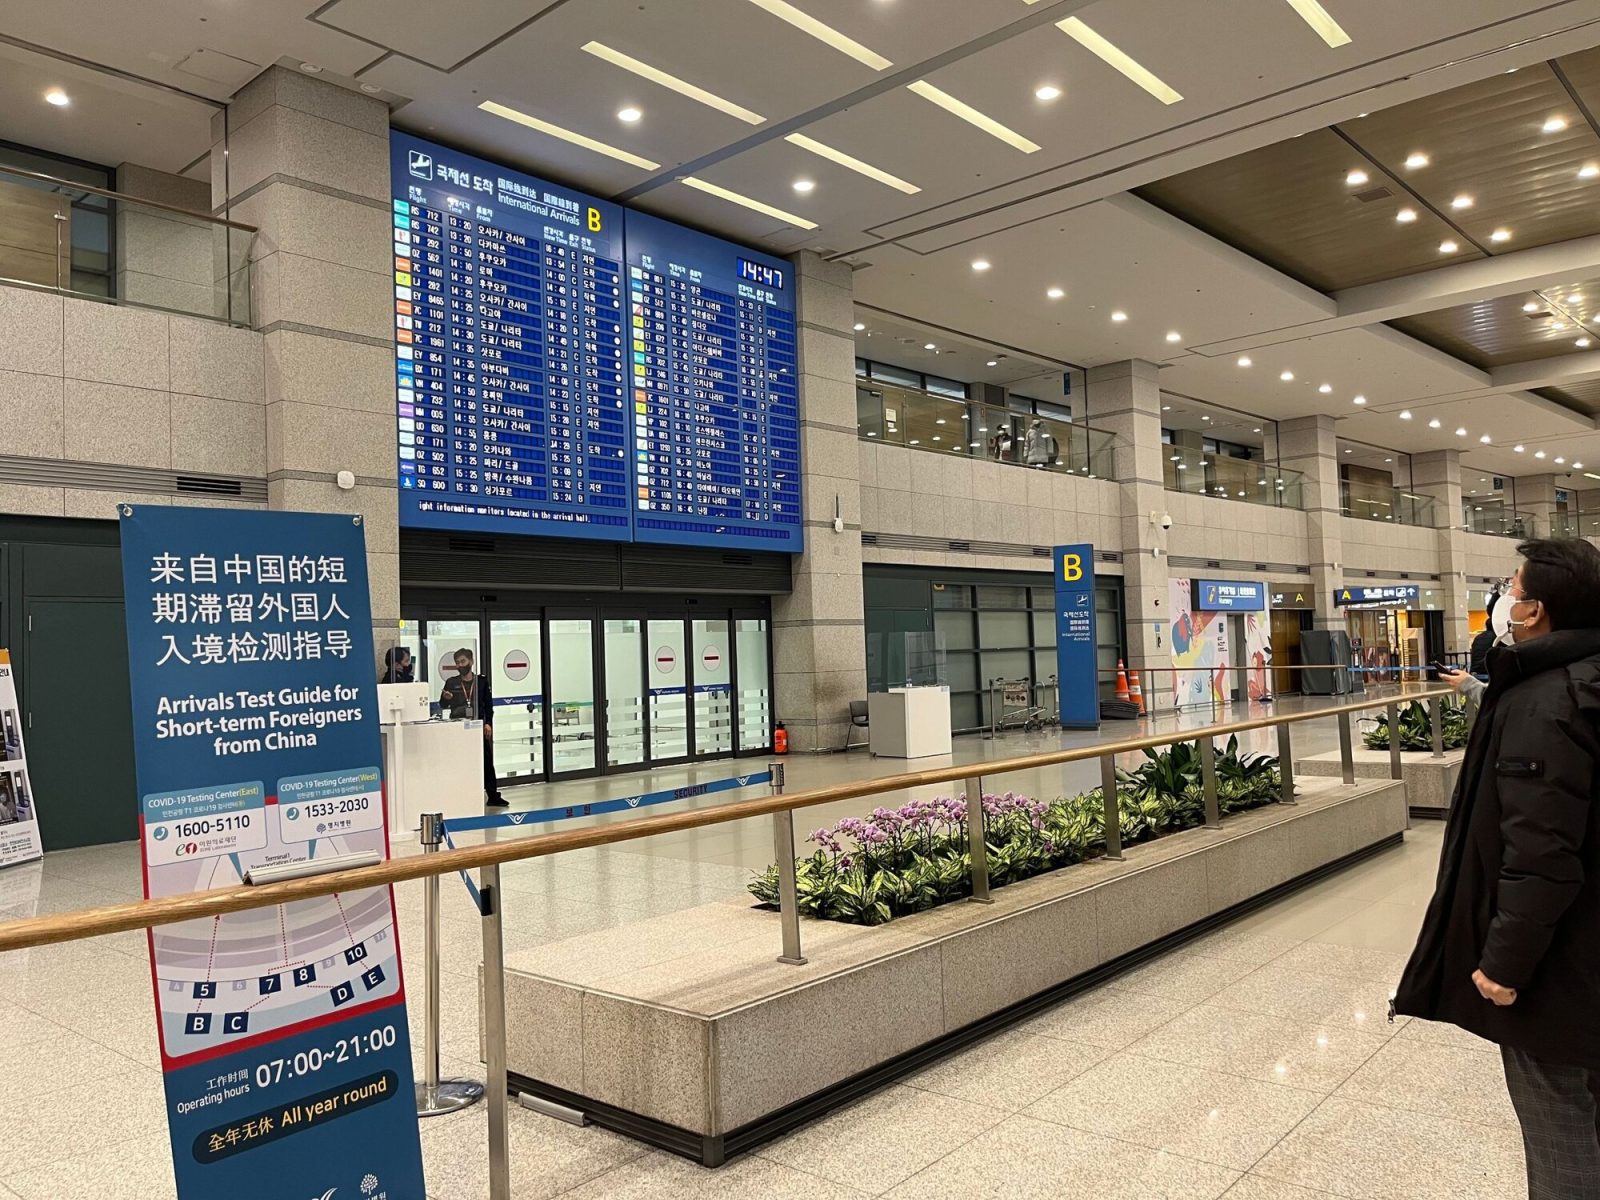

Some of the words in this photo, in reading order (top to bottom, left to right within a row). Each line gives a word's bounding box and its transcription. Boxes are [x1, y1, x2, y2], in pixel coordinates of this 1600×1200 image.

[437, 164, 470, 188] 국제선
[473, 177, 493, 195] 도착
[409, 193, 427, 205] Flight
[498, 192, 549, 217] International
[550, 209, 580, 226] Arrivals
[476, 213, 491, 222] From
[588, 207, 601, 232] B
[427, 210, 438, 221] 712
[478, 225, 502, 239] 오사카/
[505, 232, 525, 245] 간사이
[582, 254, 594, 265] 지연
[411, 248, 420, 258] OZ
[479, 265, 492, 276] 로마
[427, 224, 438, 234] 742
[478, 238, 505, 253] 다카마쓰
[583, 267, 594, 277] 도착
[478, 251, 506, 267] 후쿠오카
[583, 280, 595, 289] 도착
[743, 261, 782, 289] 14:47
[428, 266, 442, 277] 1401
[479, 279, 507, 293] 후쿠오카
[583, 305, 595, 315] 지연
[412, 291, 421, 300] EY
[584, 330, 596, 340] 도착
[429, 308, 443, 319] 1101
[480, 320, 498, 331] 도쿄/
[500, 324, 521, 336] 나리타
[479, 293, 504, 305] 오사카/
[507, 298, 527, 311] 간사이
[584, 317, 596, 327] 도착
[428, 322, 441, 333] 212
[480, 333, 498, 344] 도쿄/
[501, 338, 521, 349] 나리타
[585, 355, 597, 365] 도착
[414, 349, 422, 359] EY
[480, 362, 508, 375] 아부다비
[586, 382, 598, 391] 도착
[480, 347, 501, 359] 삿포로
[585, 368, 597, 377] 도착
[430, 367, 441, 376] 171
[481, 376, 506, 388] 오사카/
[509, 380, 529, 392] 간사이
[586, 395, 598, 404] 도착
[430, 381, 442, 390] 404
[586, 407, 598, 417] 지연
[430, 395, 443, 405] 732
[482, 403, 500, 413] 도쿄/
[503, 406, 523, 417] 나리타
[587, 420, 599, 430] 지연
[483, 417, 507, 428] 오사카/
[510, 420, 530, 432] 간사이
[415, 435, 424, 444] OZ
[432, 437, 443, 446] 171
[483, 444, 511, 456] 오키나와
[483, 430, 497, 441] 홍콩
[588, 445, 600, 454] 도착
[770, 449, 779, 457] 지연
[416, 450, 424, 459] OZ
[431, 451, 444, 461] 502
[484, 485, 512, 496] 싱가포르
[589, 483, 601, 492] 지연
[771, 481, 780, 490] 지연
[419, 501, 433, 511] ight
[436, 502, 475, 514] information
[507, 508, 530, 518] located
[532, 510, 539, 519] in
[541, 511, 551, 520] the
[553, 512, 573, 521] arrival
[697, 495, 710, 503] 도쿄/
[150, 552, 347, 585] 来自中国的短
[1063, 553, 1083, 581] B
[1296, 593, 1304, 602] A
[1341, 590, 1351, 600] A
[152, 592, 350, 624] 期滞留外国人
[156, 630, 353, 666] 入境检测指导
[157, 692, 234, 716] Arrivals
[236, 689, 276, 708] Test
[279, 686, 331, 706] Guide
[333, 684, 359, 702] for
[156, 713, 266, 739] Short-term
[269, 707, 362, 731] Foreigners
[213, 736, 261, 756] from
[264, 731, 317, 751] China
[280, 780, 313, 792] COVID-19
[314, 779, 337, 788] Testing
[674, 784, 708, 800] SECURITY
[148, 796, 186, 809] COVID-19
[187, 793, 214, 803] Testing
[305, 797, 369, 819] 1533-2030
[175, 815, 250, 838] 1600-5110
[348, 947, 363, 960] 10
[266, 979, 274, 990] 7
[299, 968, 309, 981] 8
[368, 972, 379, 985] E
[200, 984, 209, 996] 5
[337, 987, 348, 1001] D
[193, 1017, 205, 1031] B
[231, 1017, 242, 1030] C
[256, 1024, 396, 1089] 07:00~21:00
[206, 1068, 249, 1089] 工作时间
[177, 1089, 223, 1114] Operating
[224, 1082, 250, 1103] hours
[208, 1115, 274, 1152] 全年无休
[281, 1103, 301, 1128] All
[305, 1096, 339, 1122] year
[343, 1076, 387, 1106] round
